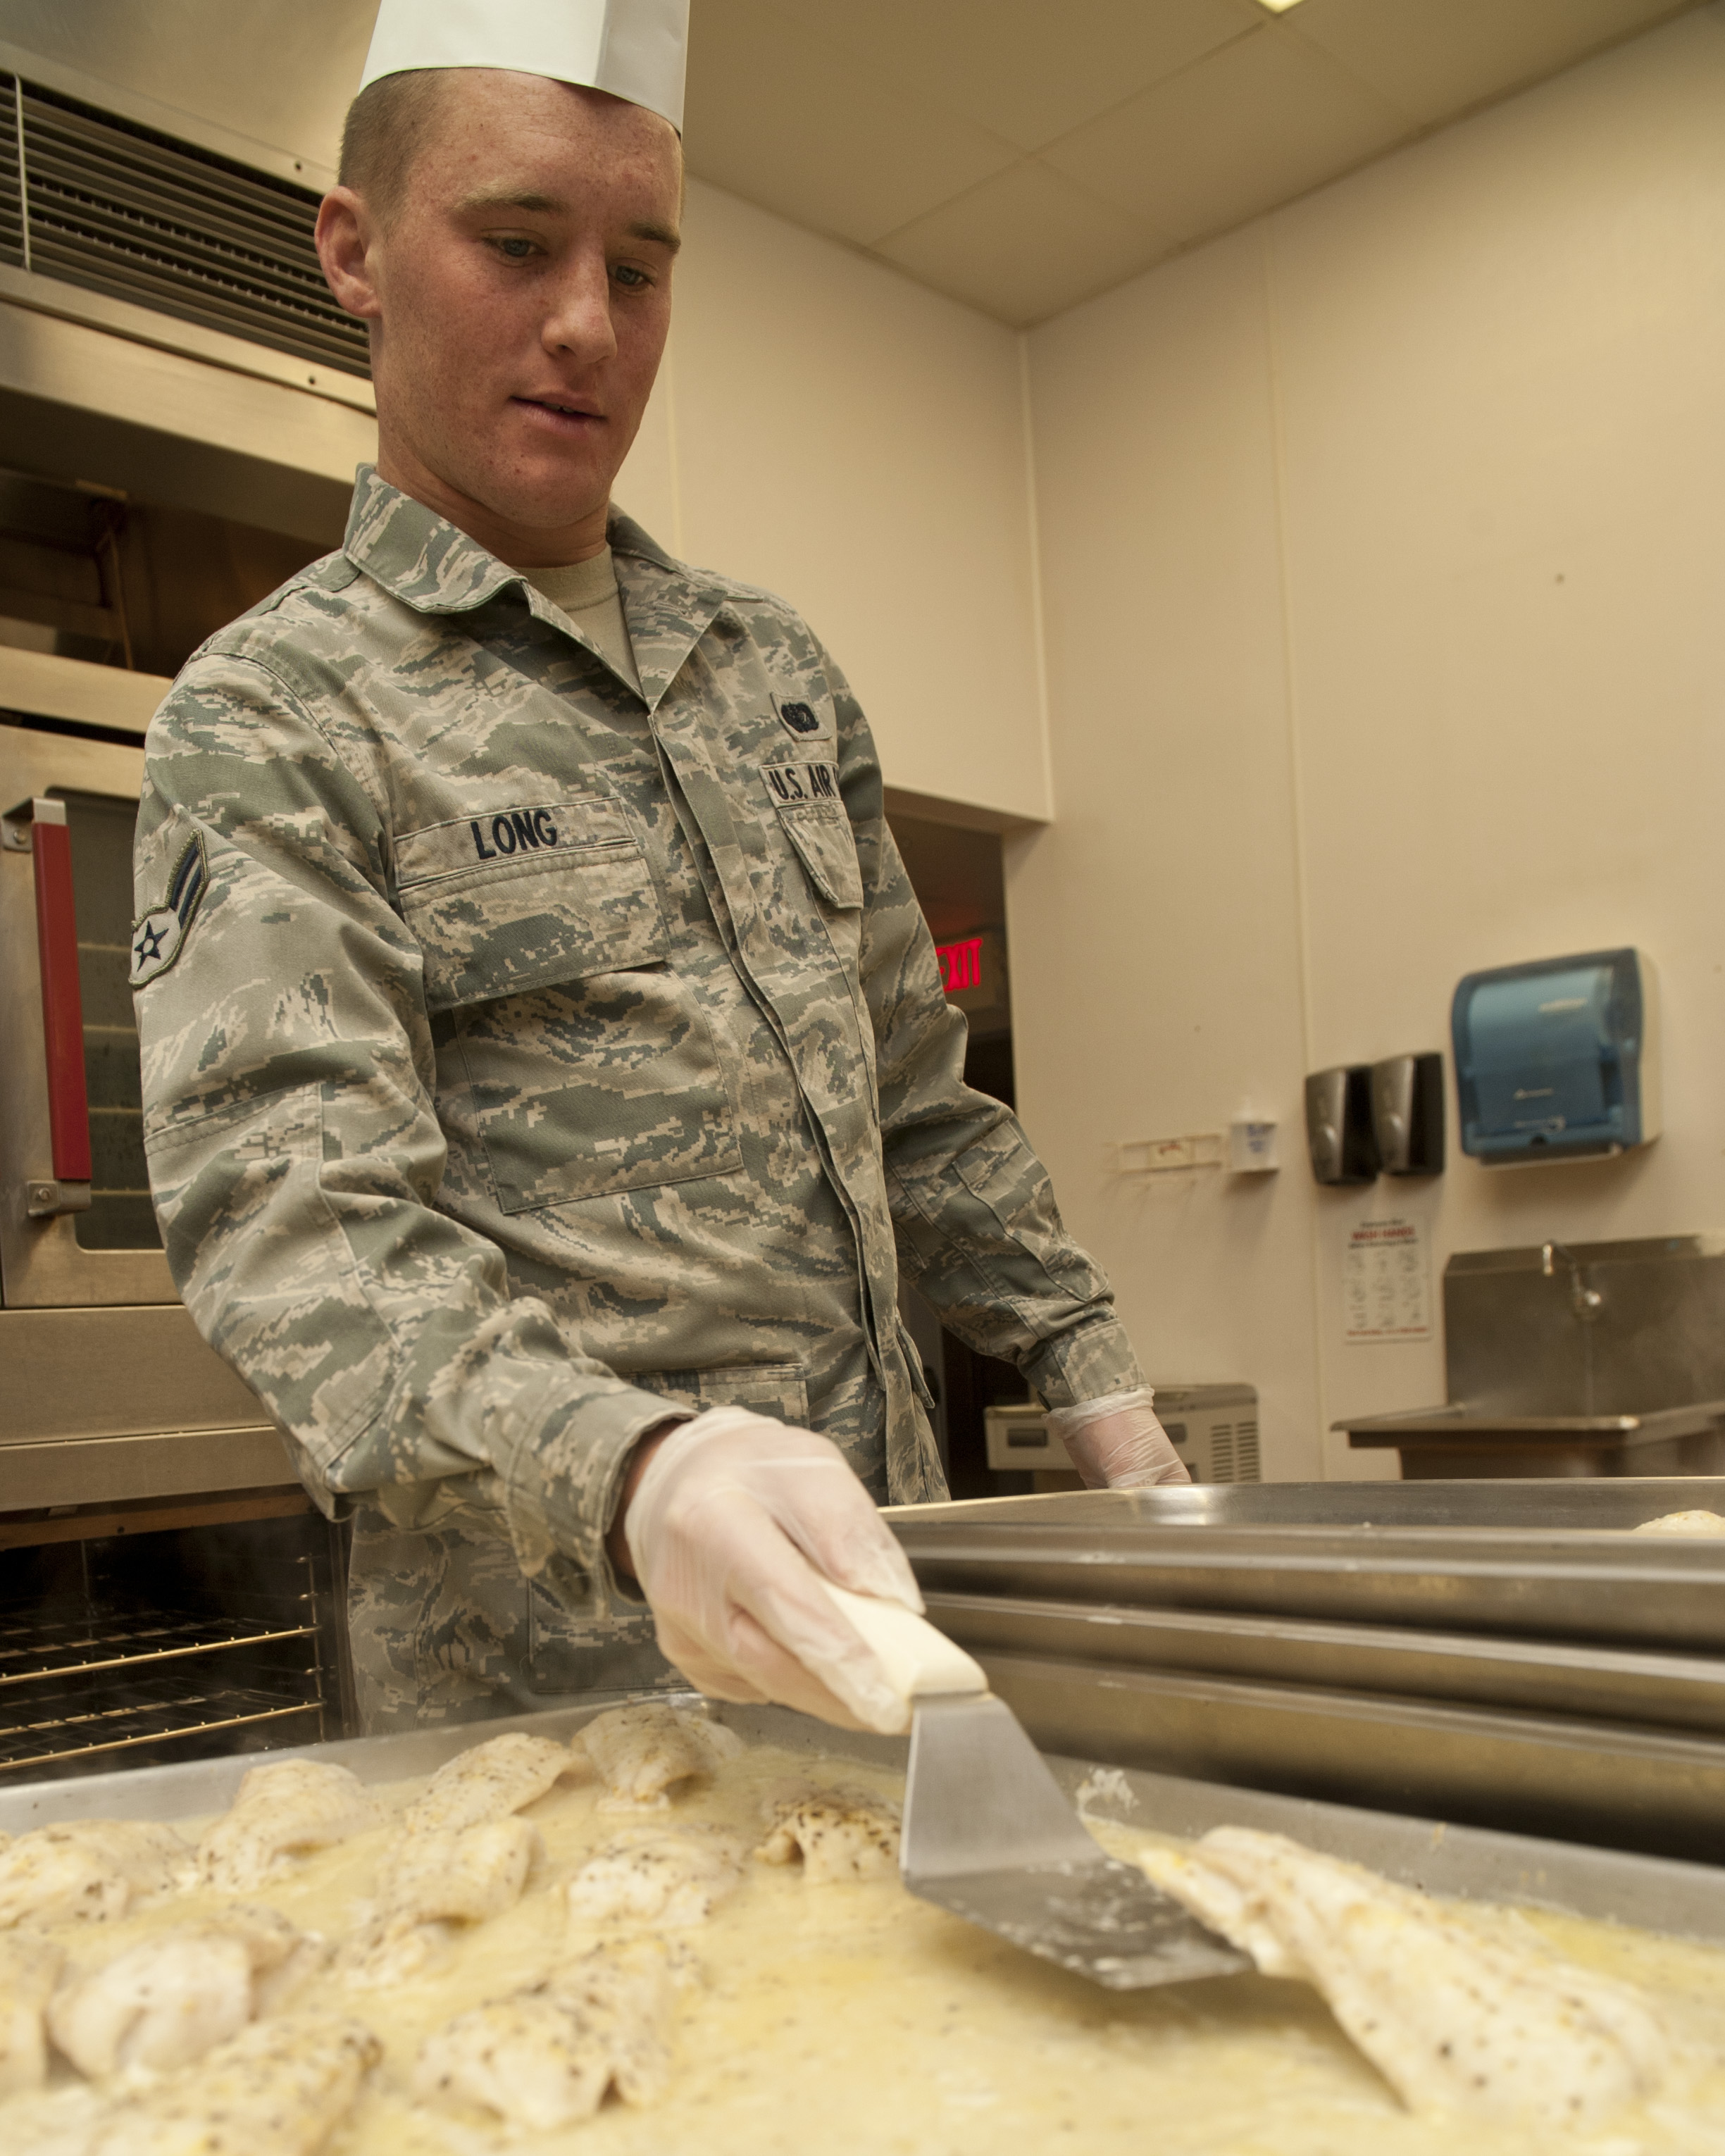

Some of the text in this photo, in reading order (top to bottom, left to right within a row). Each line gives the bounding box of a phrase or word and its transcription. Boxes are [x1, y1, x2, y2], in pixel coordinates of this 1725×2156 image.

[768, 768, 808, 800] U.S.
[808, 765, 836, 797] AIR
[471, 810, 557, 859] LONG
